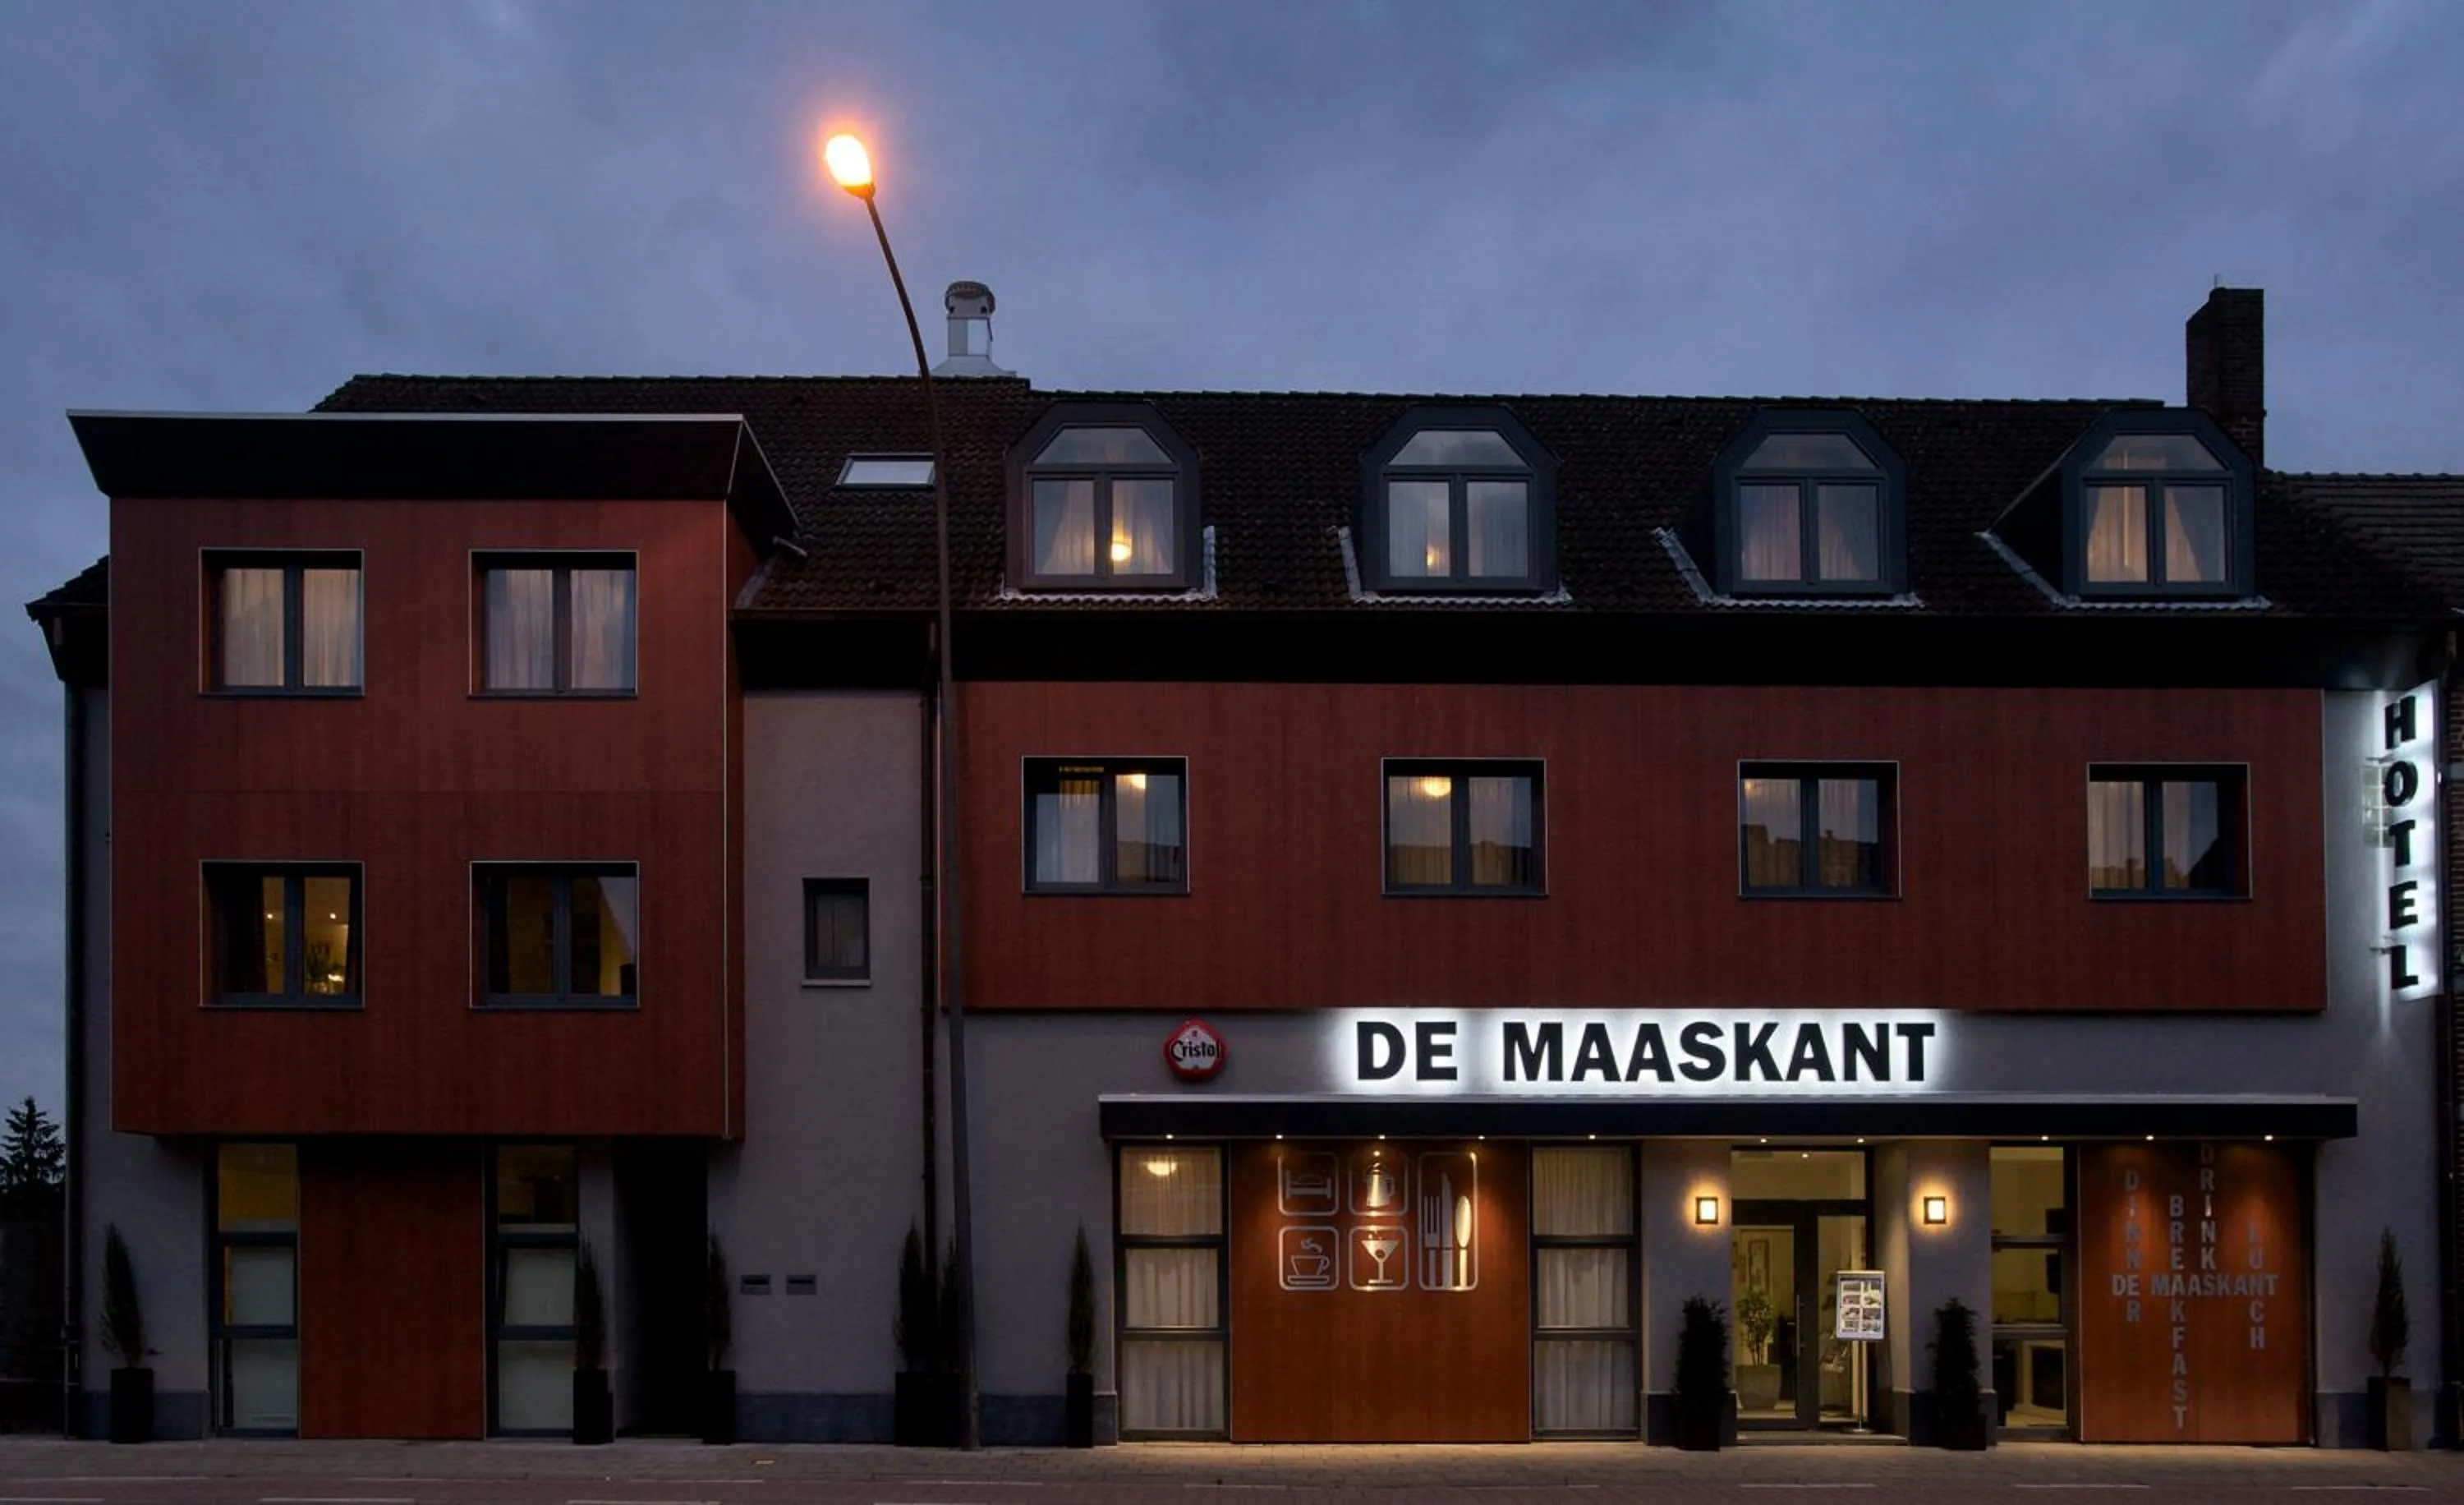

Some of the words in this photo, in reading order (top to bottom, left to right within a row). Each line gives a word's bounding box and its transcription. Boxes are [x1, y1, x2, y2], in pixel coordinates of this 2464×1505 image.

[2384, 695, 2419, 990] HOTEL
[1356, 1020, 1458, 1081] DE
[1501, 1021, 1935, 1083] MAASKANT
[2112, 1274, 2141, 1297] DE
[2150, 1274, 2279, 1297] MAASKANT
[2168, 1194, 2188, 1429] BREAKFAST
